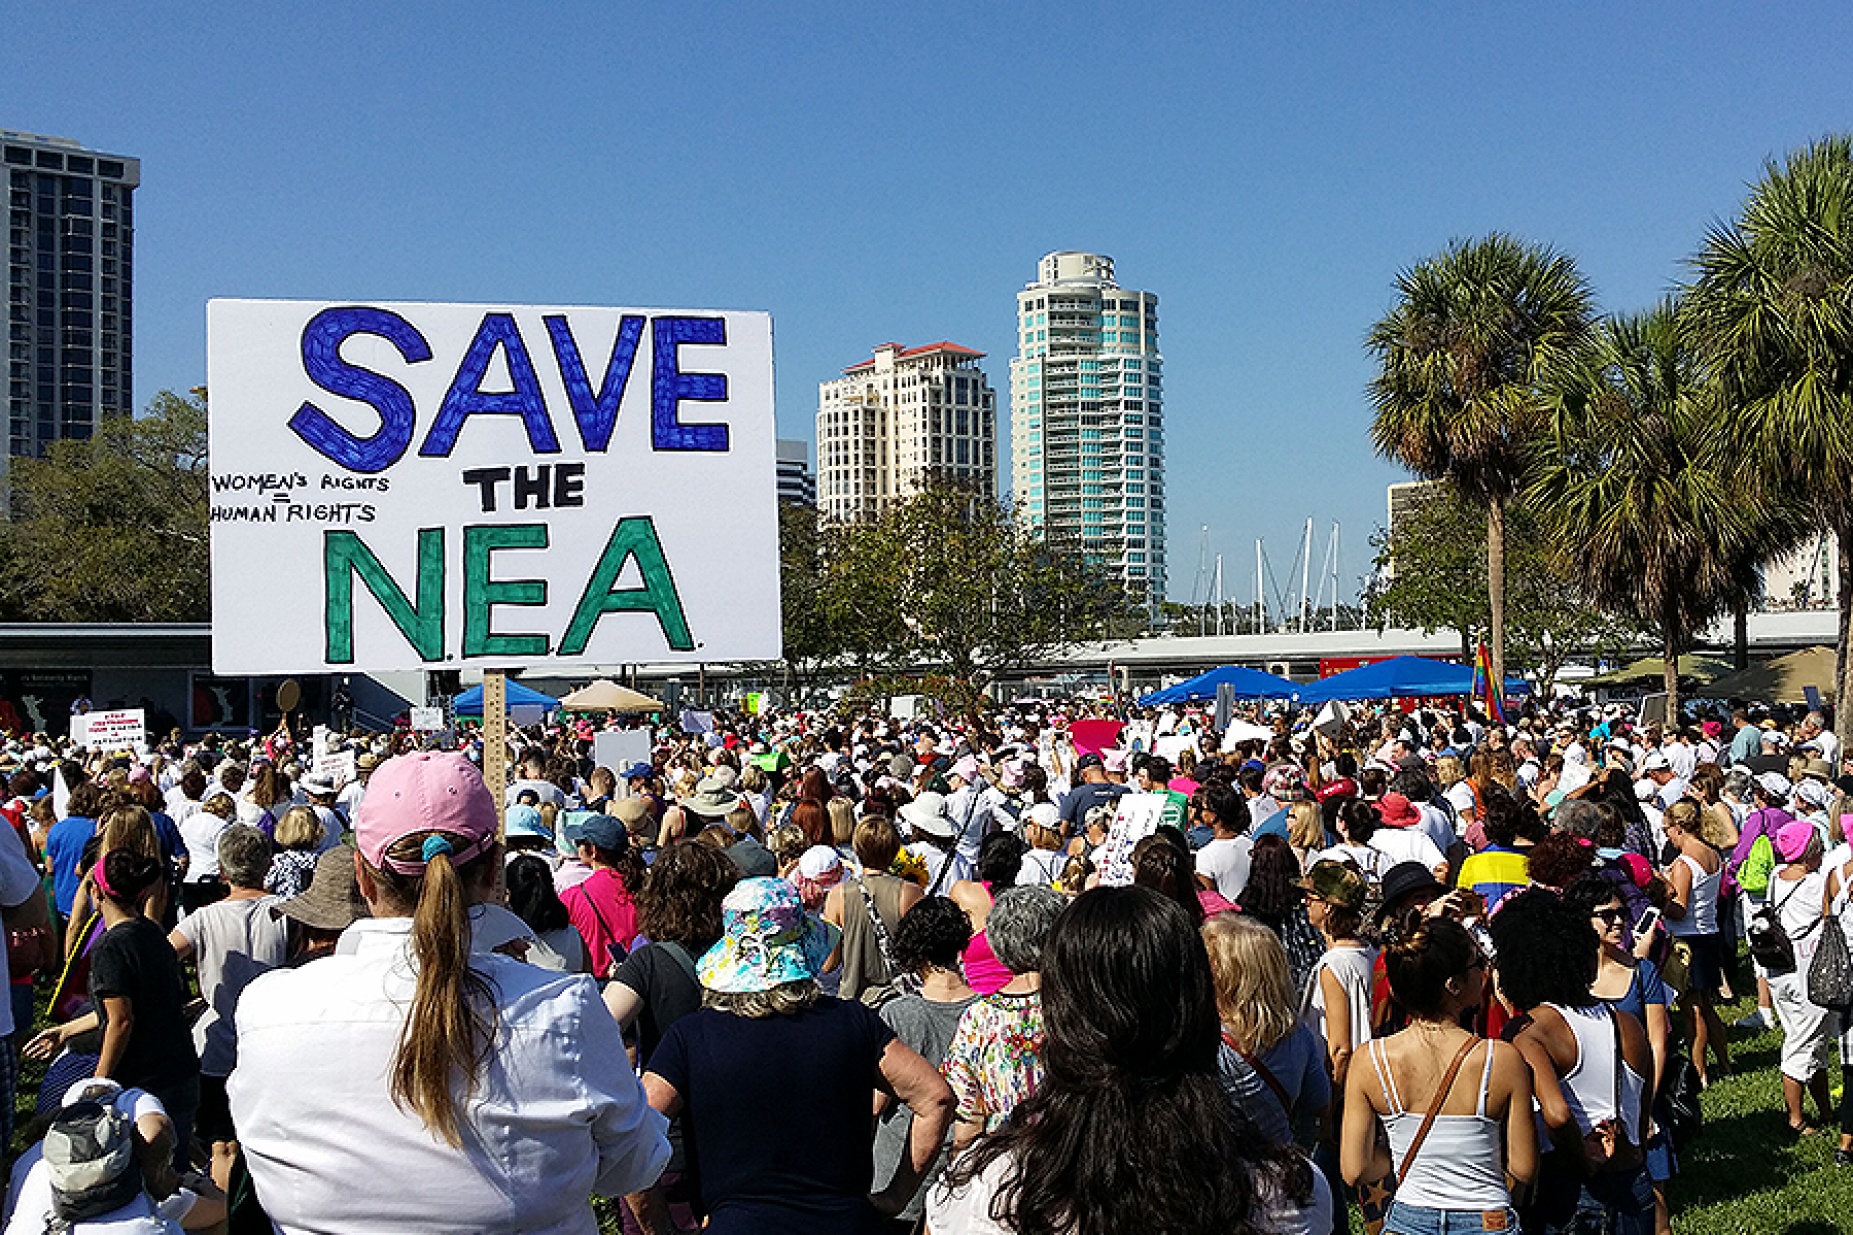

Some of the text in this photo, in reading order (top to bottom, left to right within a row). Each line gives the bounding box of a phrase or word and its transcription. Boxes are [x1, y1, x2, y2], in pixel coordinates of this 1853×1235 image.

[286, 306, 729, 474] SAVE
[320, 474, 390, 492] RIGHTS
[463, 462, 585, 512] THE
[210, 503, 376, 524] HUMAN RIGHTS
